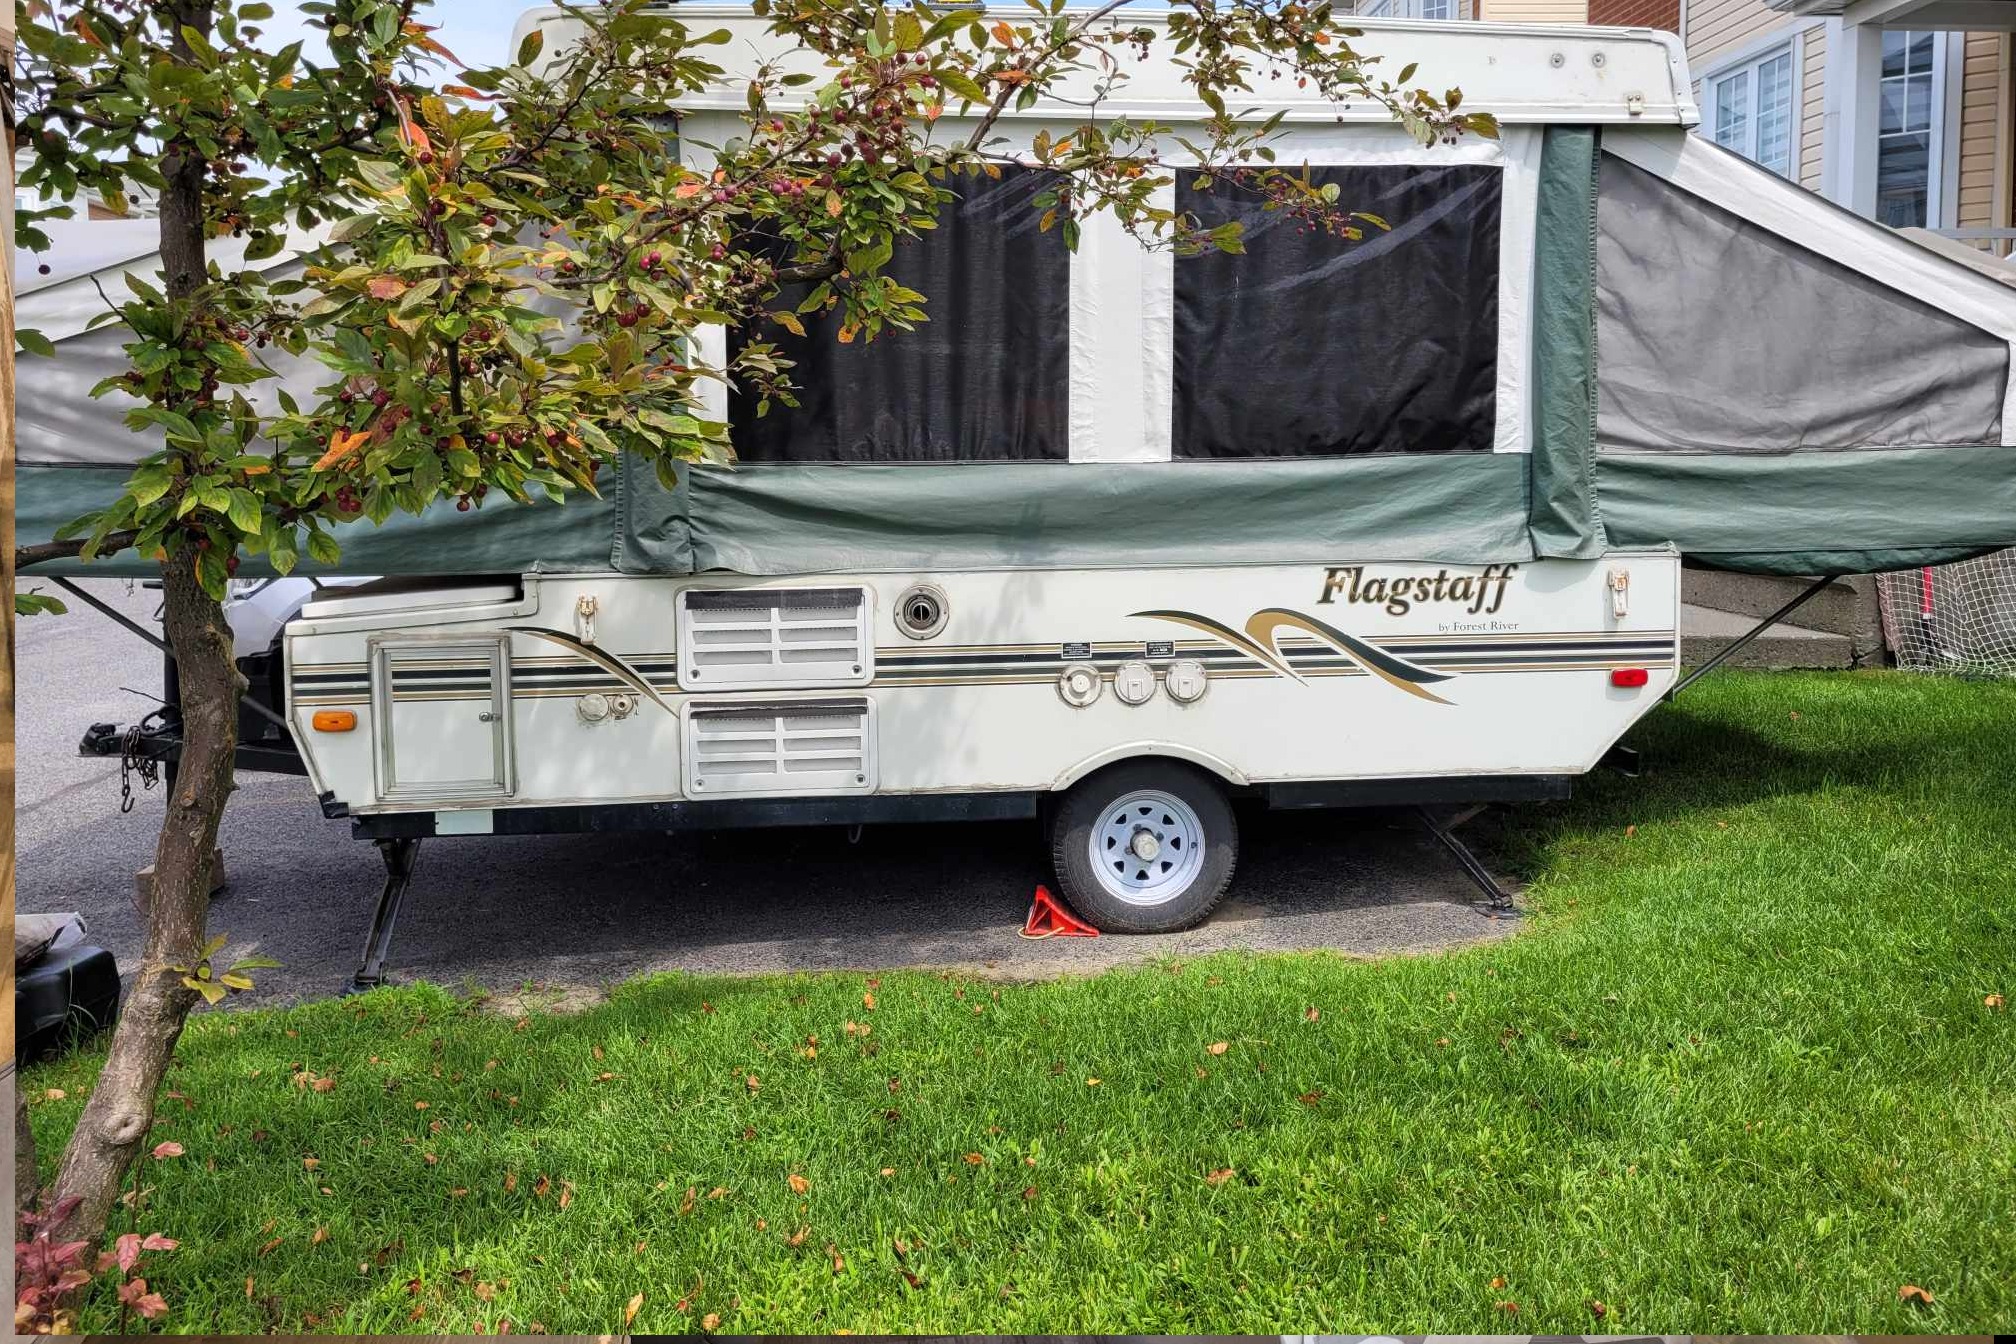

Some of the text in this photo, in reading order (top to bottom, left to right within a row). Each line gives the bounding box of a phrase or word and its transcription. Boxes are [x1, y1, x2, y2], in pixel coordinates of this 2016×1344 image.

[1317, 563, 1519, 616] Flagstaff
[1438, 620, 1519, 633] by Forest River
